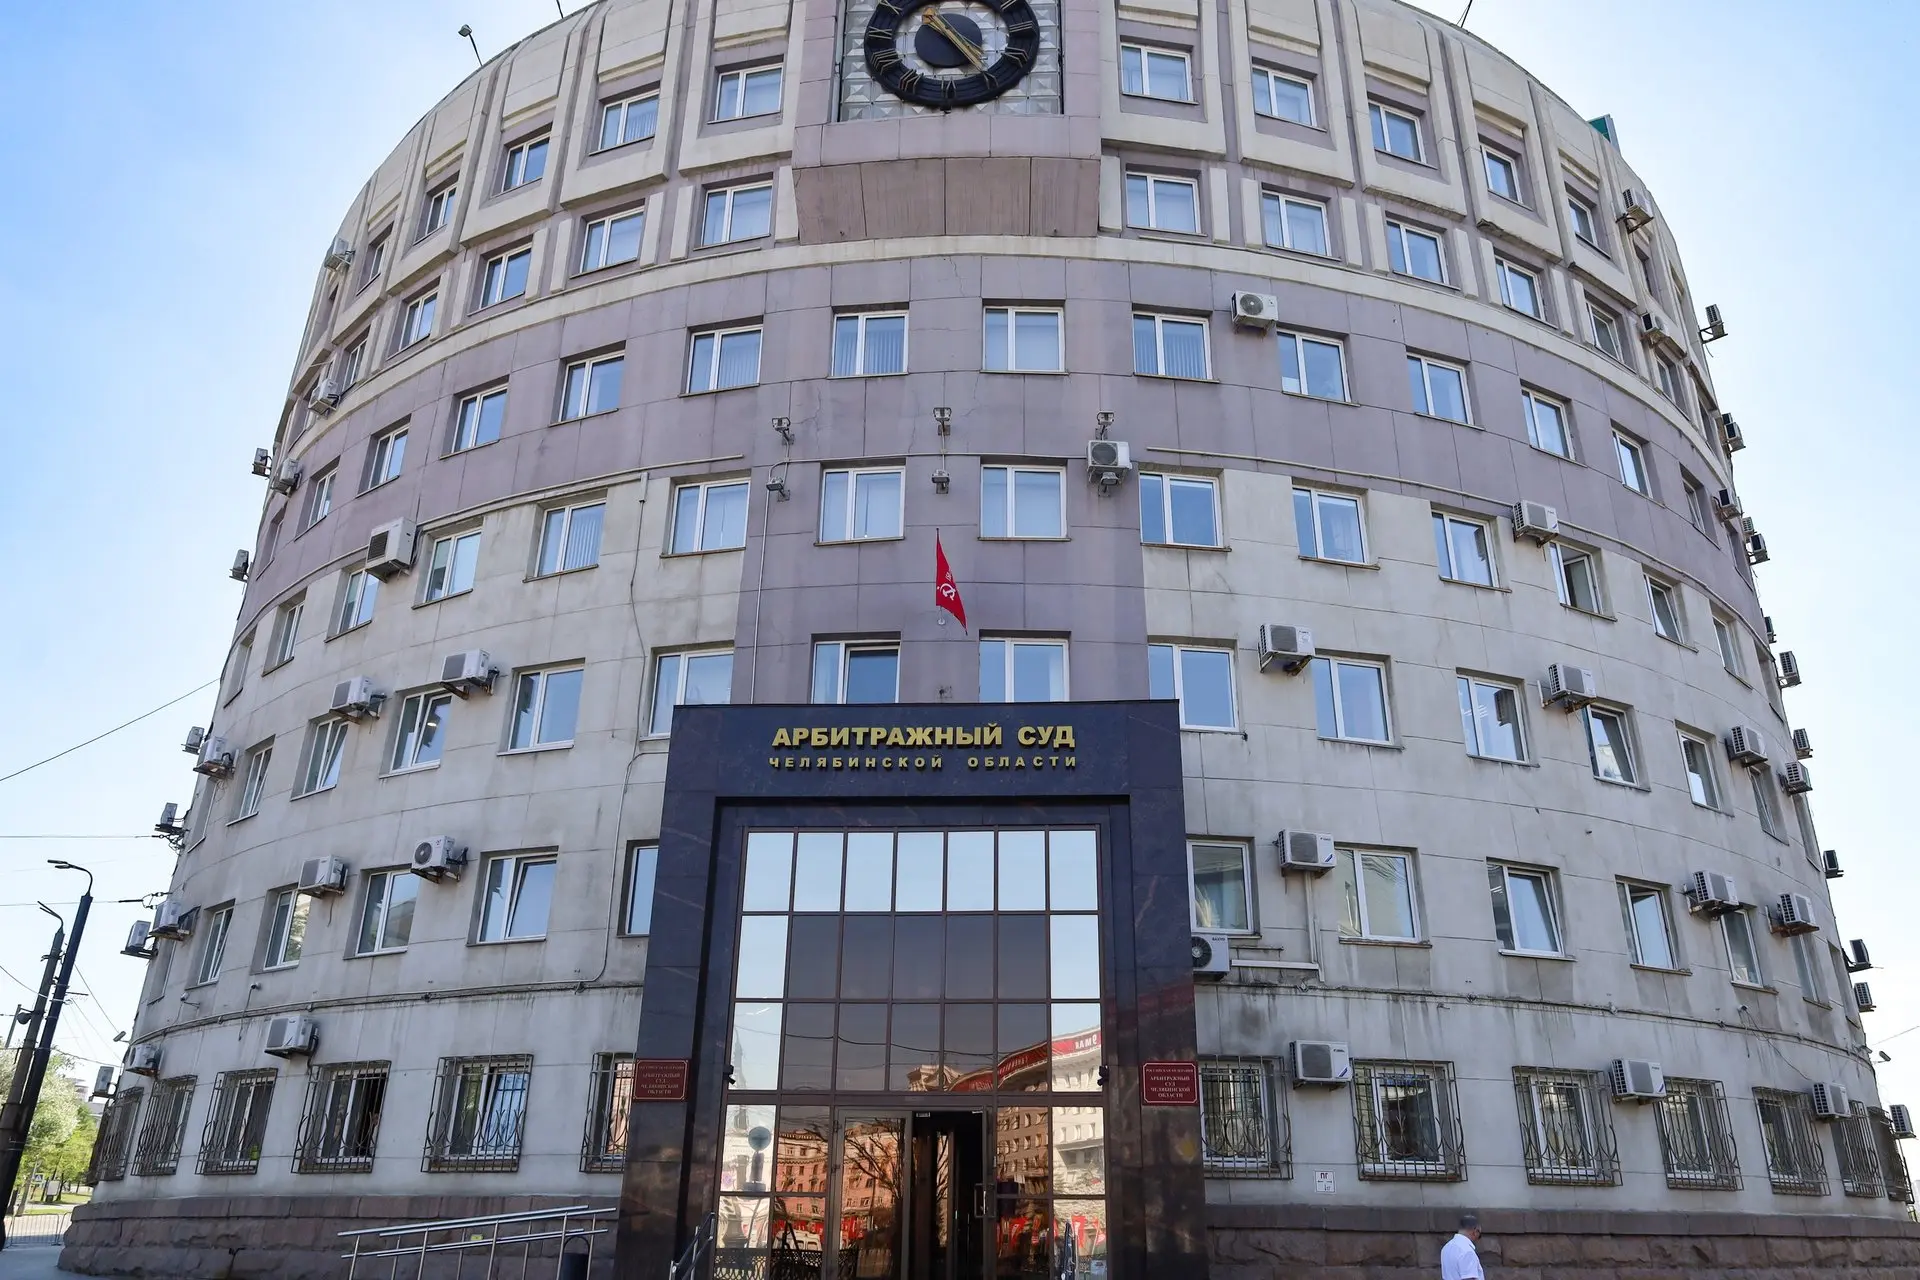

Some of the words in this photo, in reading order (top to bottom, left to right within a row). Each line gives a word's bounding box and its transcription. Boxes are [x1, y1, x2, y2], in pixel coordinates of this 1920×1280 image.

[771, 722, 1002, 747] АРБИТРАЖНЫЙ
[1017, 725, 1076, 749] СУД
[769, 754, 942, 769] ЧЕЛЯБИНСКОЙ
[968, 756, 1077, 768] ОБЛАСТИ
